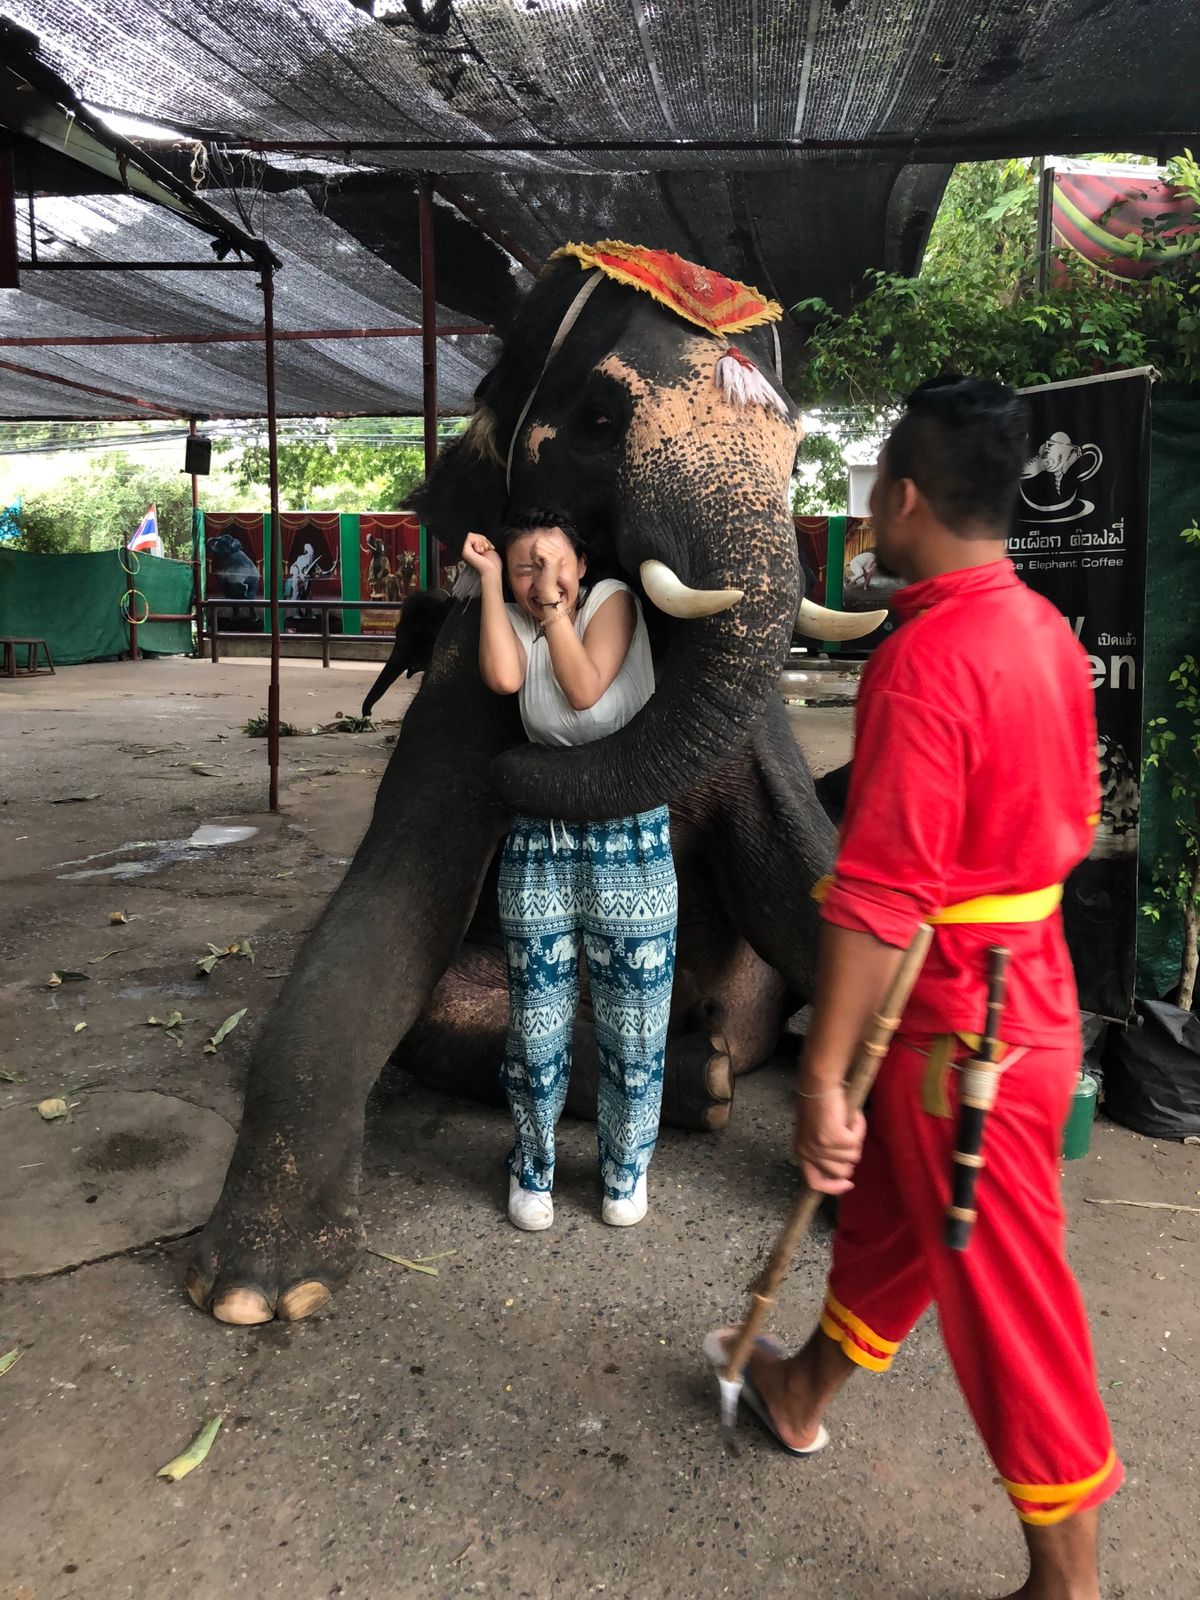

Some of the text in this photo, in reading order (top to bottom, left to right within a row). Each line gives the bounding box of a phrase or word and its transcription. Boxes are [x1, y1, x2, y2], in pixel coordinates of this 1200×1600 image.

[1028, 560, 1078, 571] Elephant
[1081, 557, 1124, 568] Coffee
[1097, 632, 1137, 646] เปิดแล้ว
